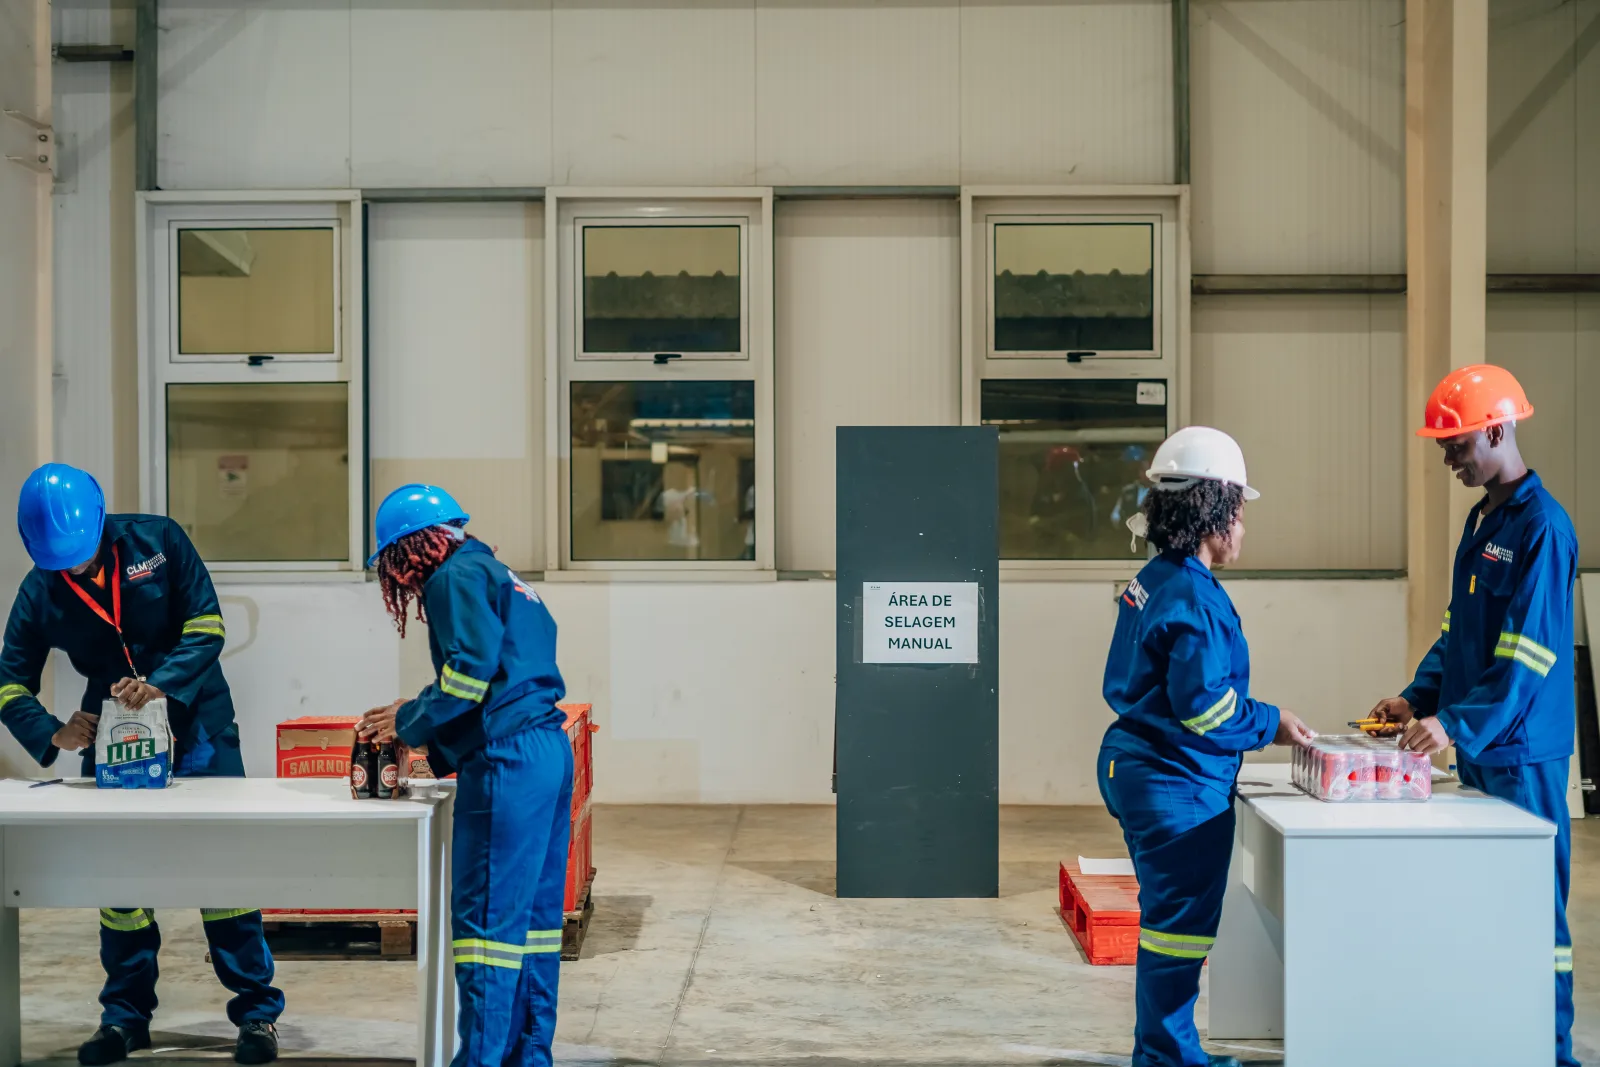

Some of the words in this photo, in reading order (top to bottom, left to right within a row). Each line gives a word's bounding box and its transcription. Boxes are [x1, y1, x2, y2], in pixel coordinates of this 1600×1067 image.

[126, 561, 148, 575] CLM
[888, 591, 928, 607] ÁREA
[932, 595, 952, 607] DE
[884, 616, 956, 628] SELAGEM
[888, 637, 953, 650] MANUAL
[112, 741, 151, 764] LITE
[290, 760, 350, 775] SMIRNOF
